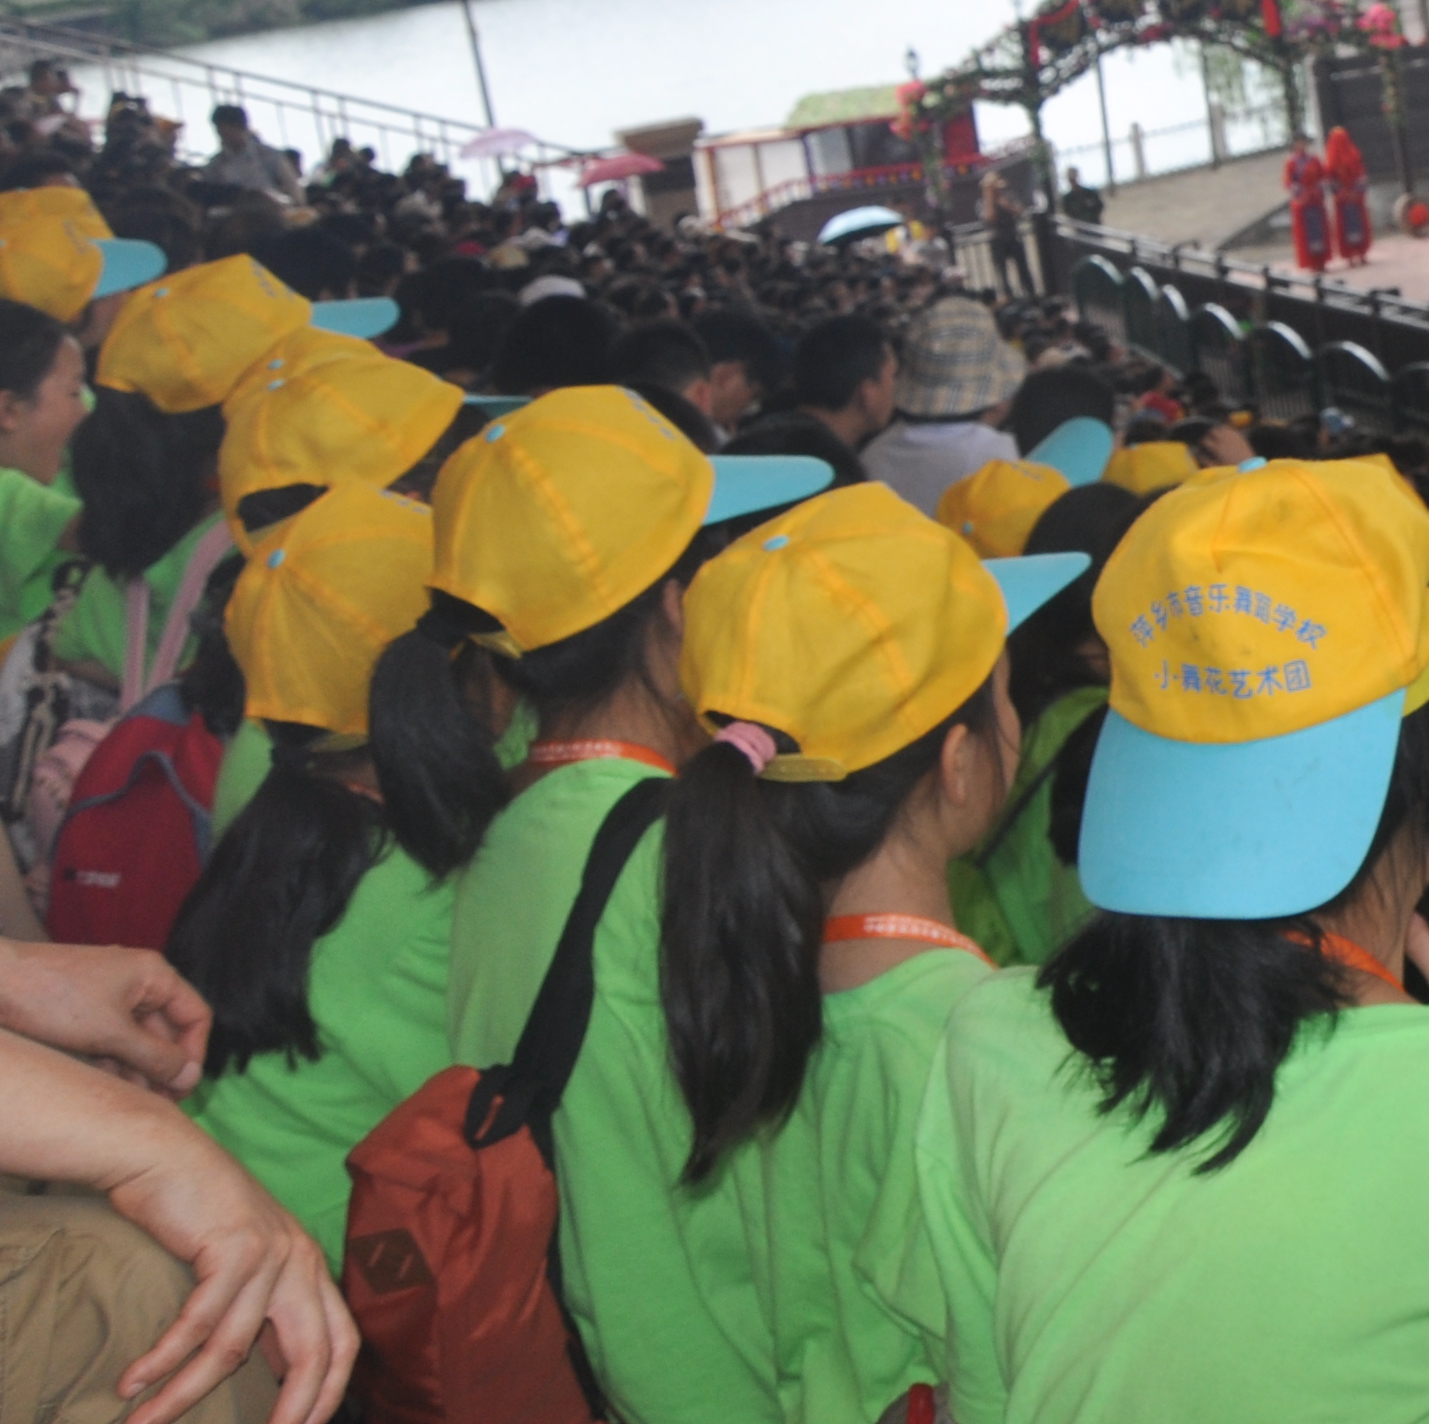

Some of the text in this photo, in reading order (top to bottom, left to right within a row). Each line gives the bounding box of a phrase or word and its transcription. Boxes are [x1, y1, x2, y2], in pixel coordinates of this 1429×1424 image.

[1129, 583, 1328, 650] 萍乡市音乐舞蹈学校
[1154, 658, 1313, 700] 小舞花艺术团
